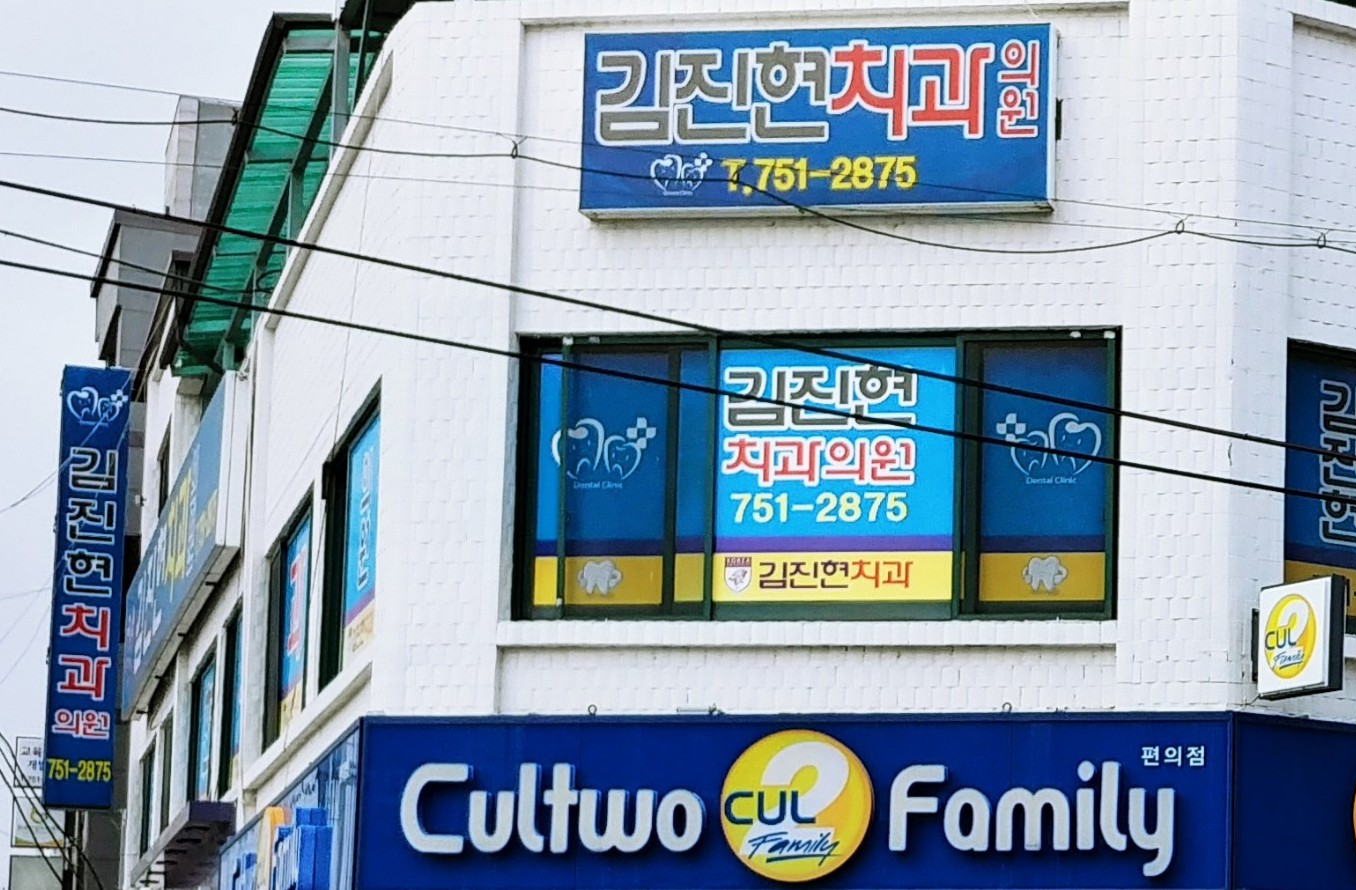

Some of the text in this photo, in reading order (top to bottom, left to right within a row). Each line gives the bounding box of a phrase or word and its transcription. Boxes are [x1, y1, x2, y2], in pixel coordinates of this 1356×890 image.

[597, 40, 994, 144] 김진현치과
[721, 364, 917, 430] 김진현
[721, 436, 916, 486] 치과의원
[730, 492, 908, 524] 751-2875
[759, 559, 914, 589] 김진현치과
[47, 758, 112, 782] 751-2875
[1140, 745, 1206, 766] 편의점
[400, 760, 1175, 877] Cultwo Family
